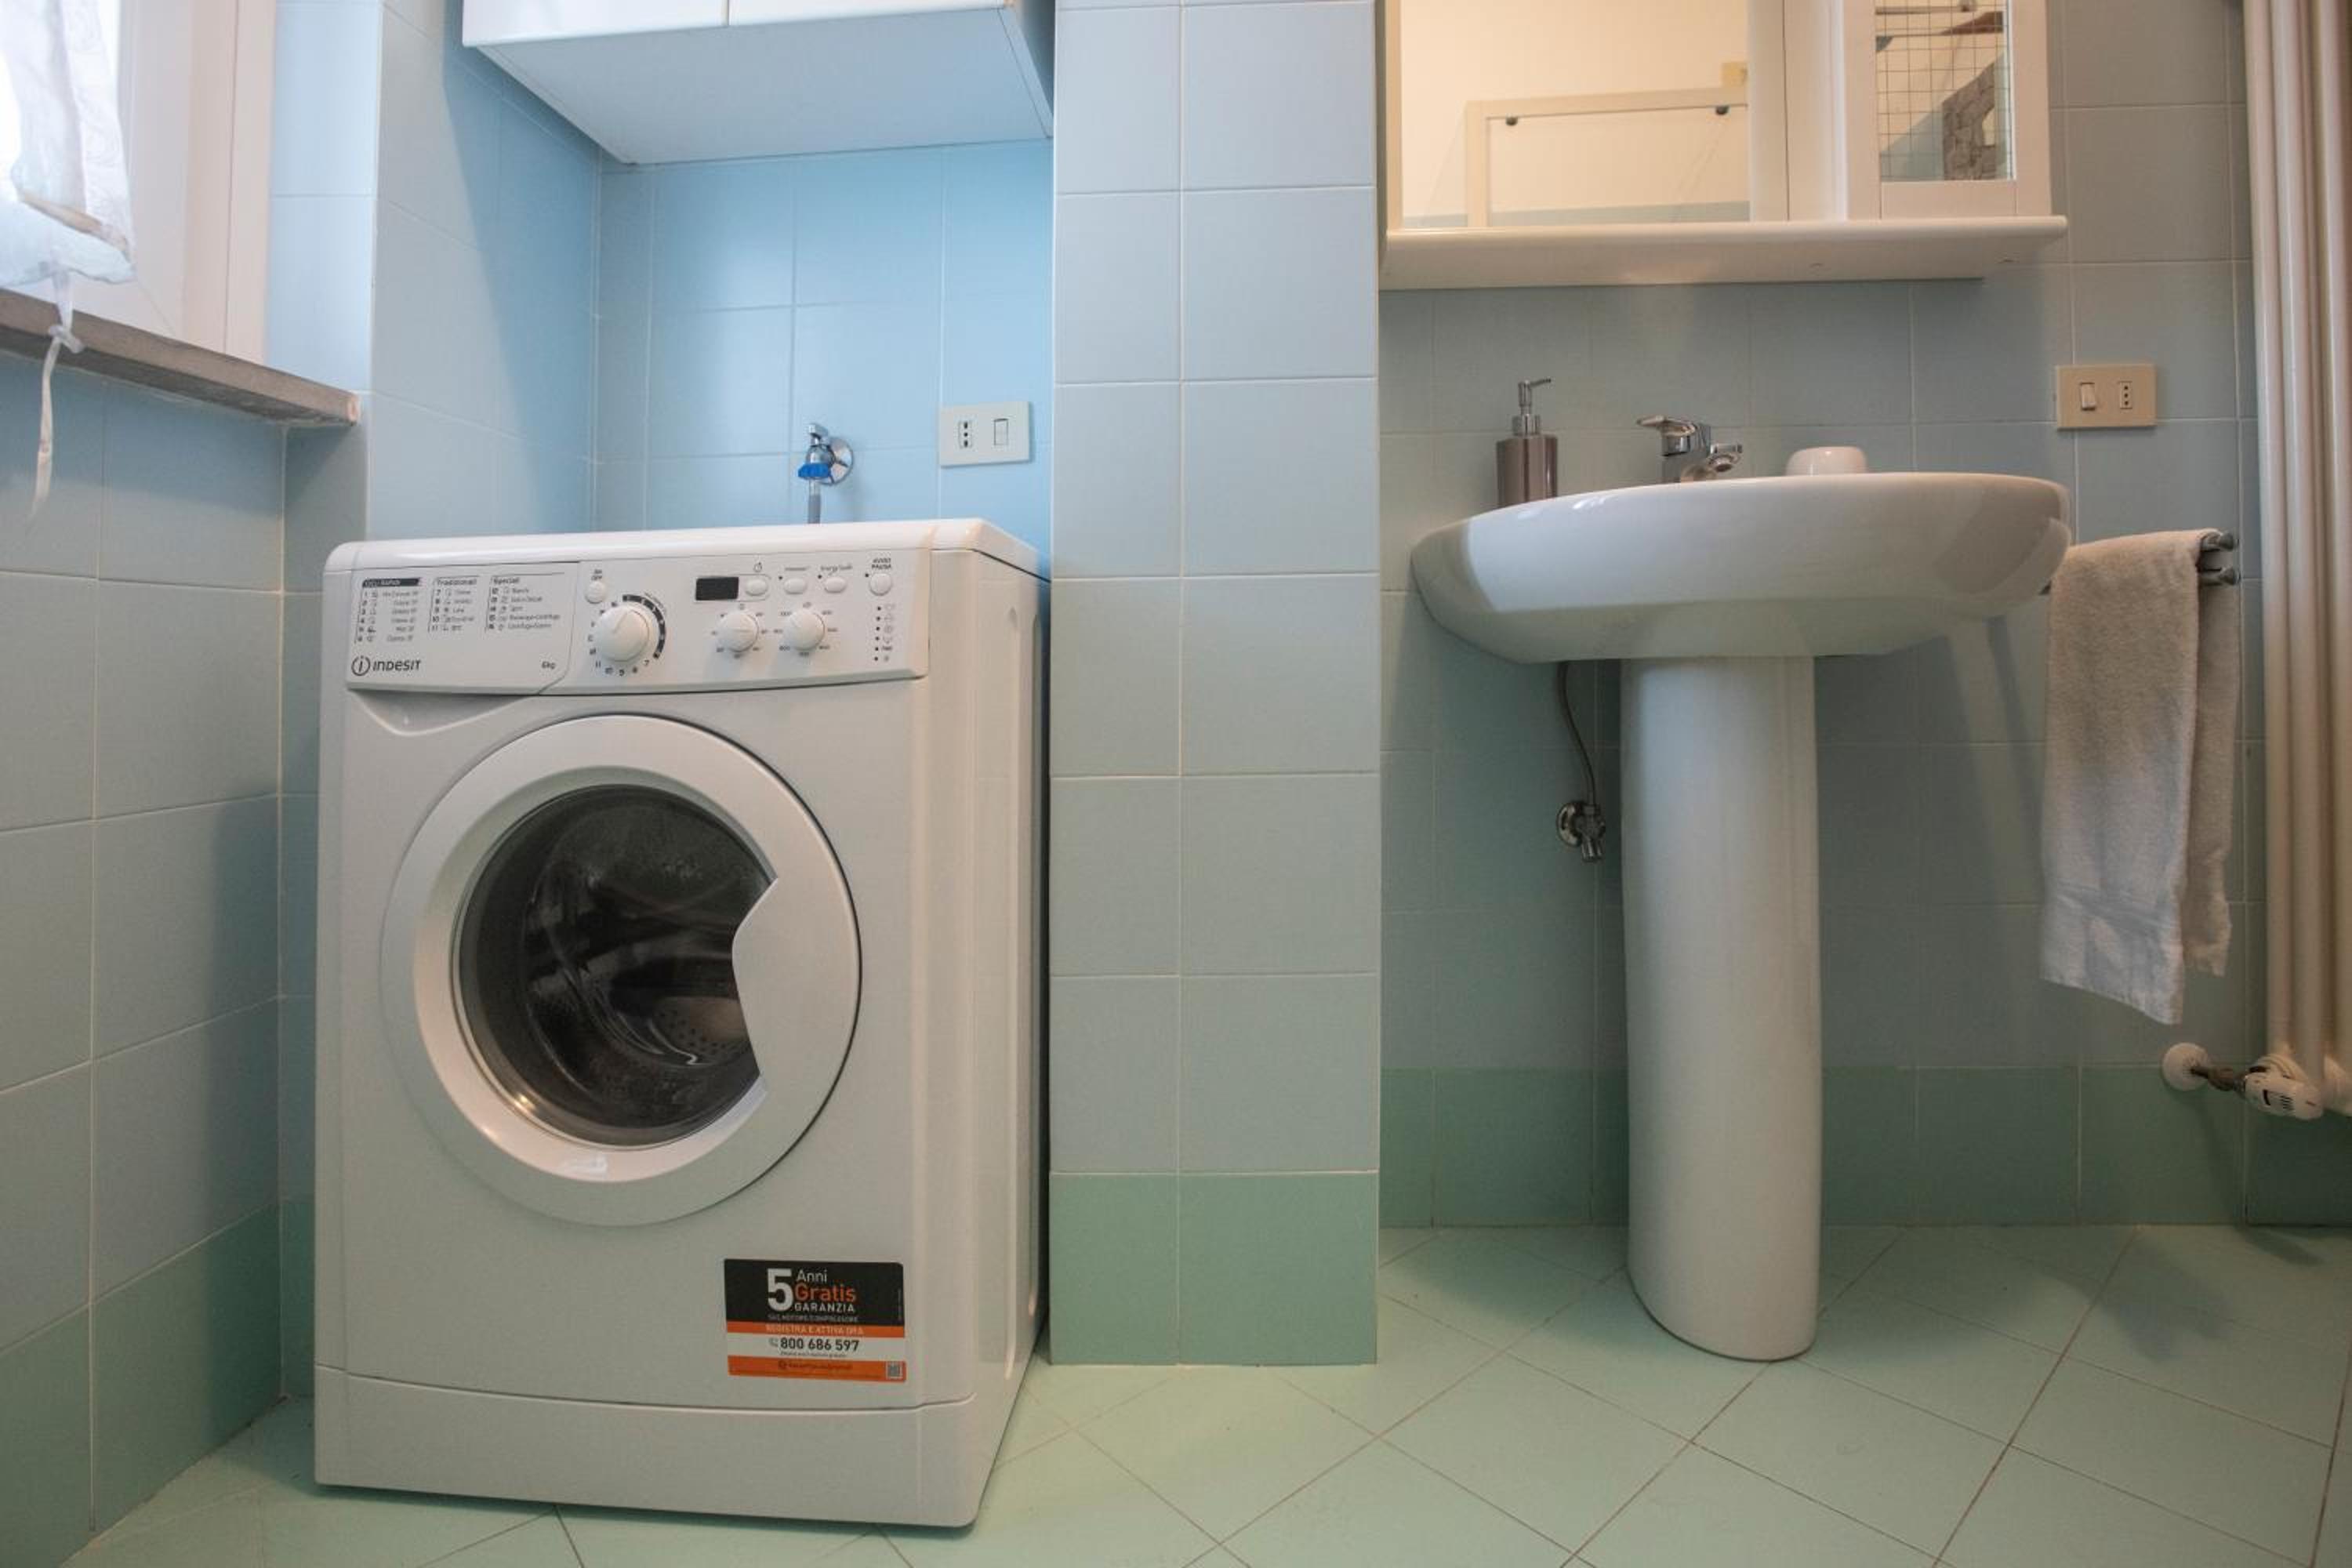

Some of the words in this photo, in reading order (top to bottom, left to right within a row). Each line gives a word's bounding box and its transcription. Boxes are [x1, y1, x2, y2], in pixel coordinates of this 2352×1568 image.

[796, 1269, 828, 1283] Anni
[767, 1268, 794, 1312] 5
[794, 1282, 857, 1302] Gratis
[794, 1302, 855, 1312] GARANZIA
[780, 1337, 804, 1349] 800
[808, 1338, 832, 1351] 686
[835, 1338, 860, 1352] 597
